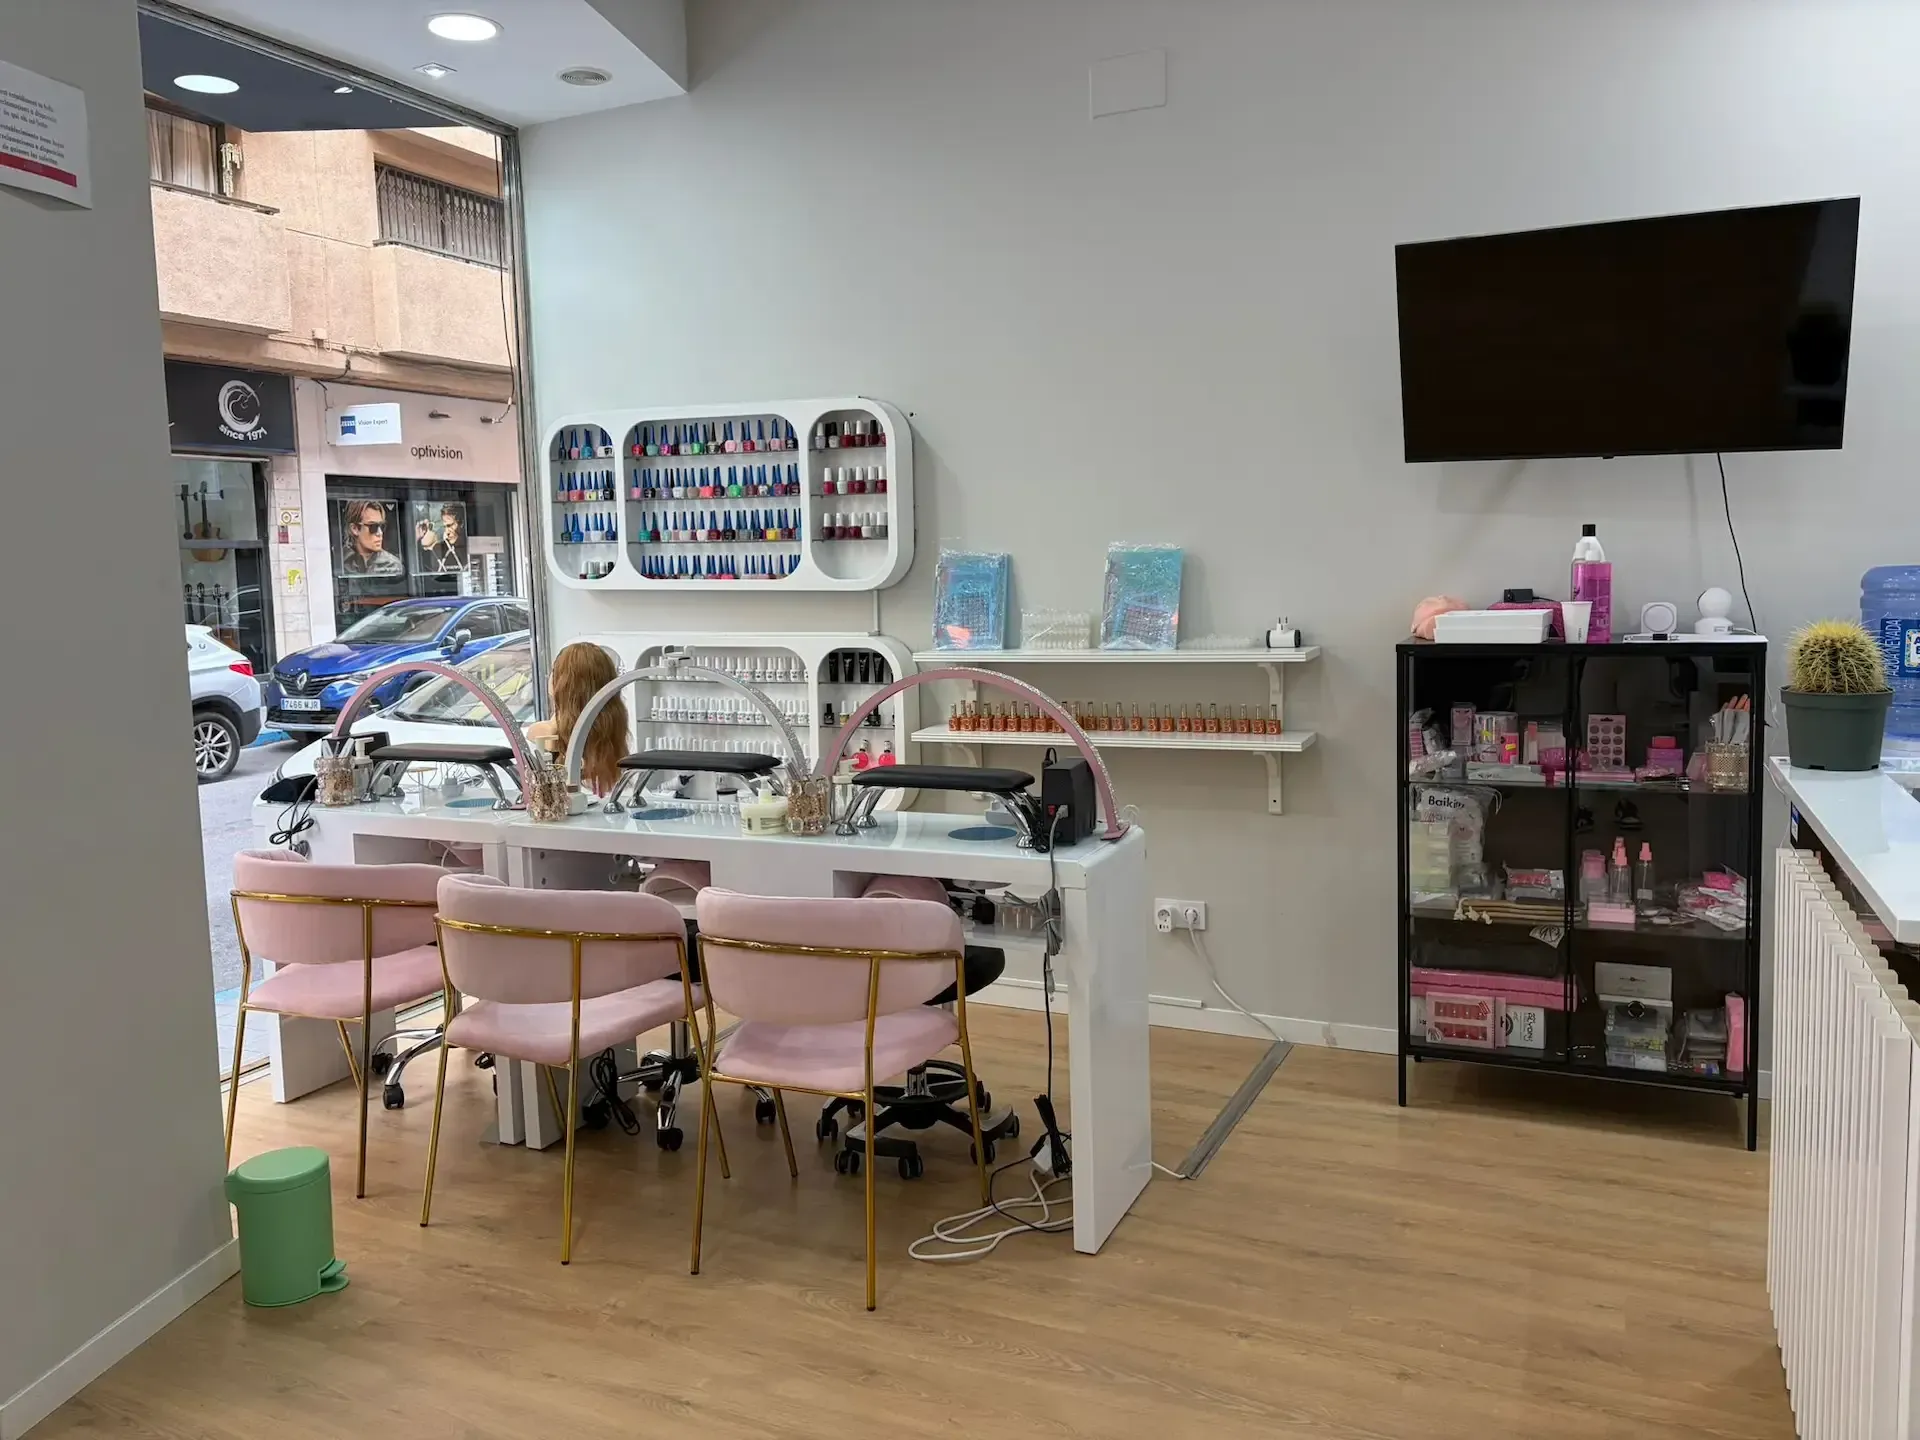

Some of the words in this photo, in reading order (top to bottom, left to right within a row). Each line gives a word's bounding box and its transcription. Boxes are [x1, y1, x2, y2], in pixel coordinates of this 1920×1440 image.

[218, 424, 245, 441] since
[246, 426, 268, 441] 1971
[410, 444, 463, 460] optivision
[285, 700, 303, 709] 7466
